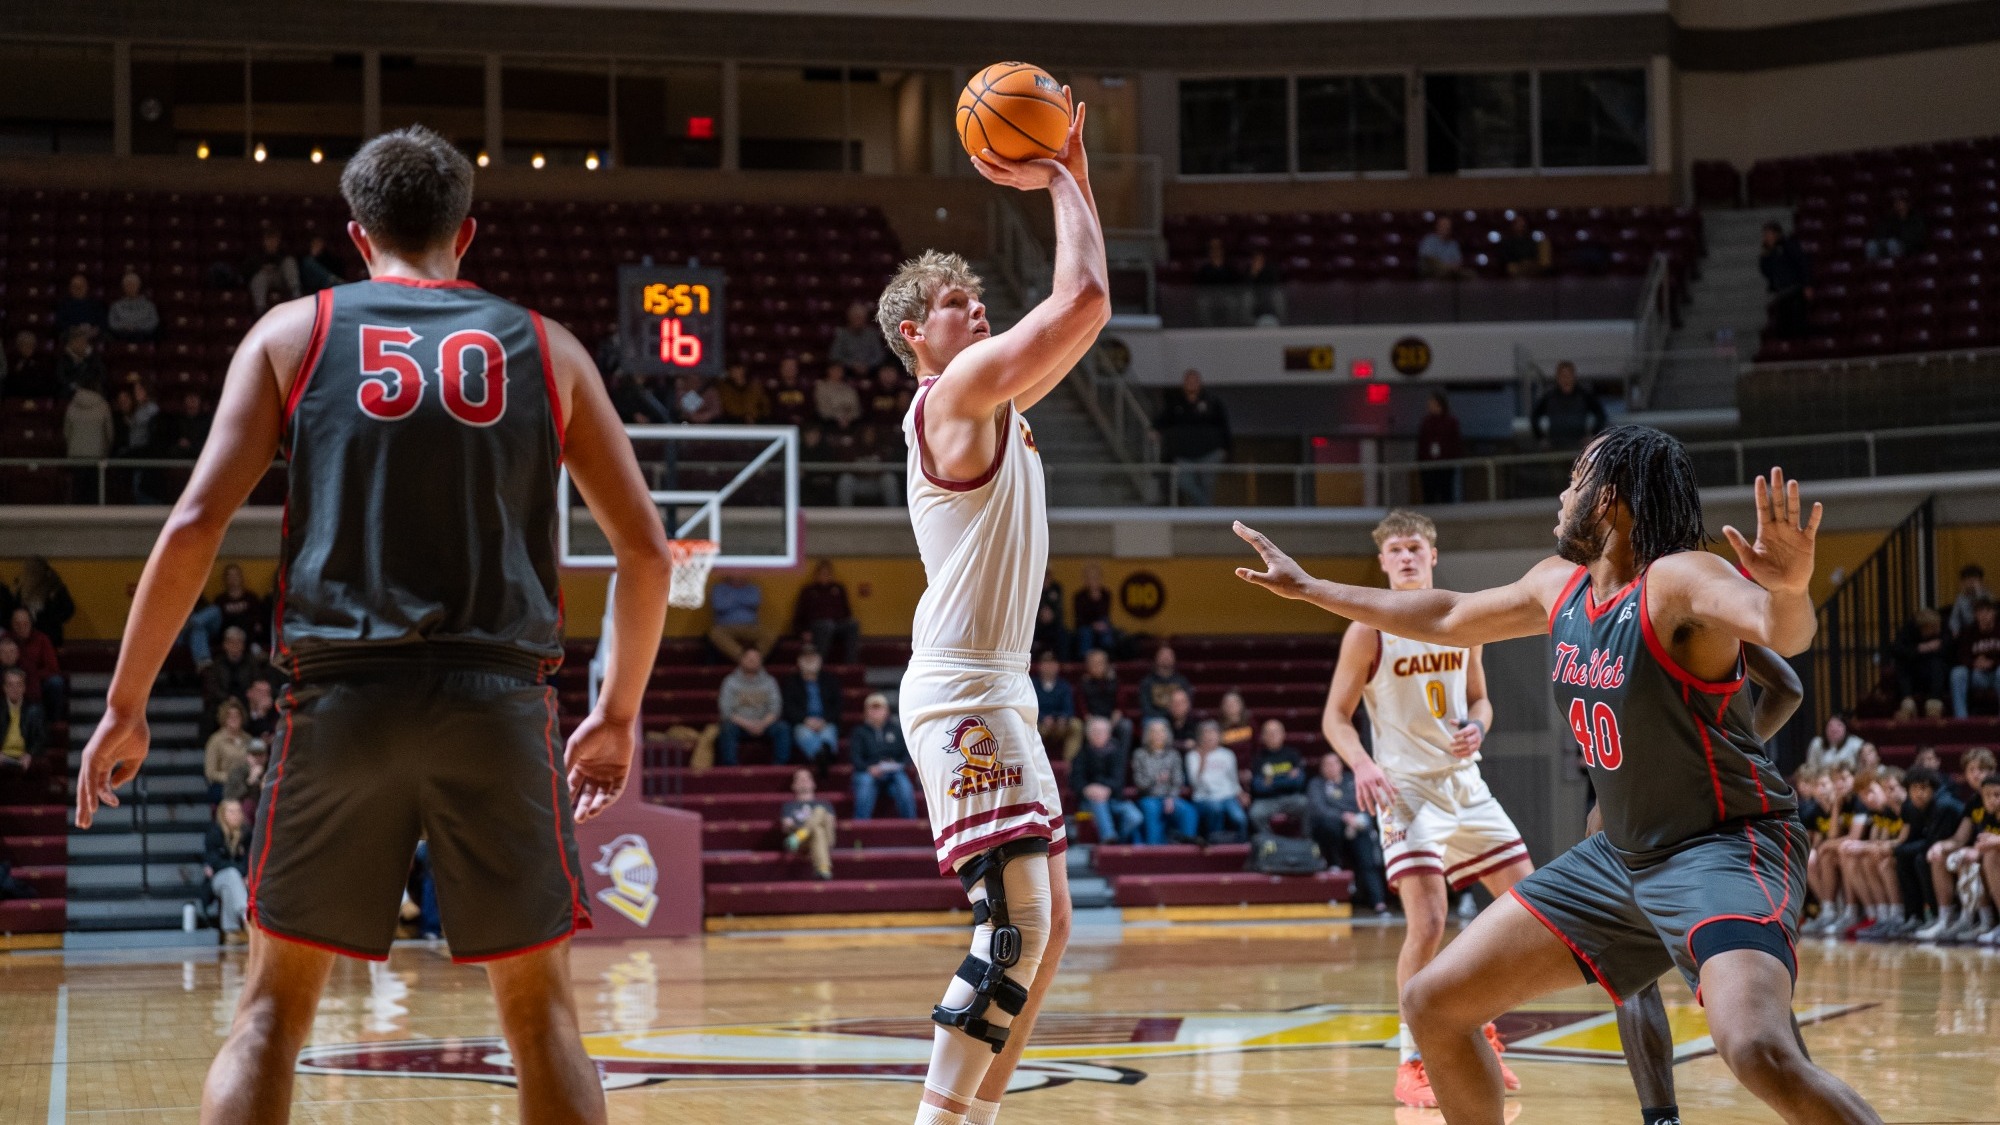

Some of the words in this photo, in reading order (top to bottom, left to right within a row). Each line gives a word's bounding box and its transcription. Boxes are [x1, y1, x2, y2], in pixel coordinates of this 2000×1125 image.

[643, 283, 710, 316] 15:57
[659, 317, 703, 368] 16
[357, 324, 510, 428] 50
[1393, 651, 1463, 677] CALVIN
[1553, 641, 1588, 686] The
[1588, 647, 1625, 689] Vet
[1425, 680, 1447, 719] 0
[1569, 698, 1623, 770] 40
[948, 765, 1023, 800] CALVIN
